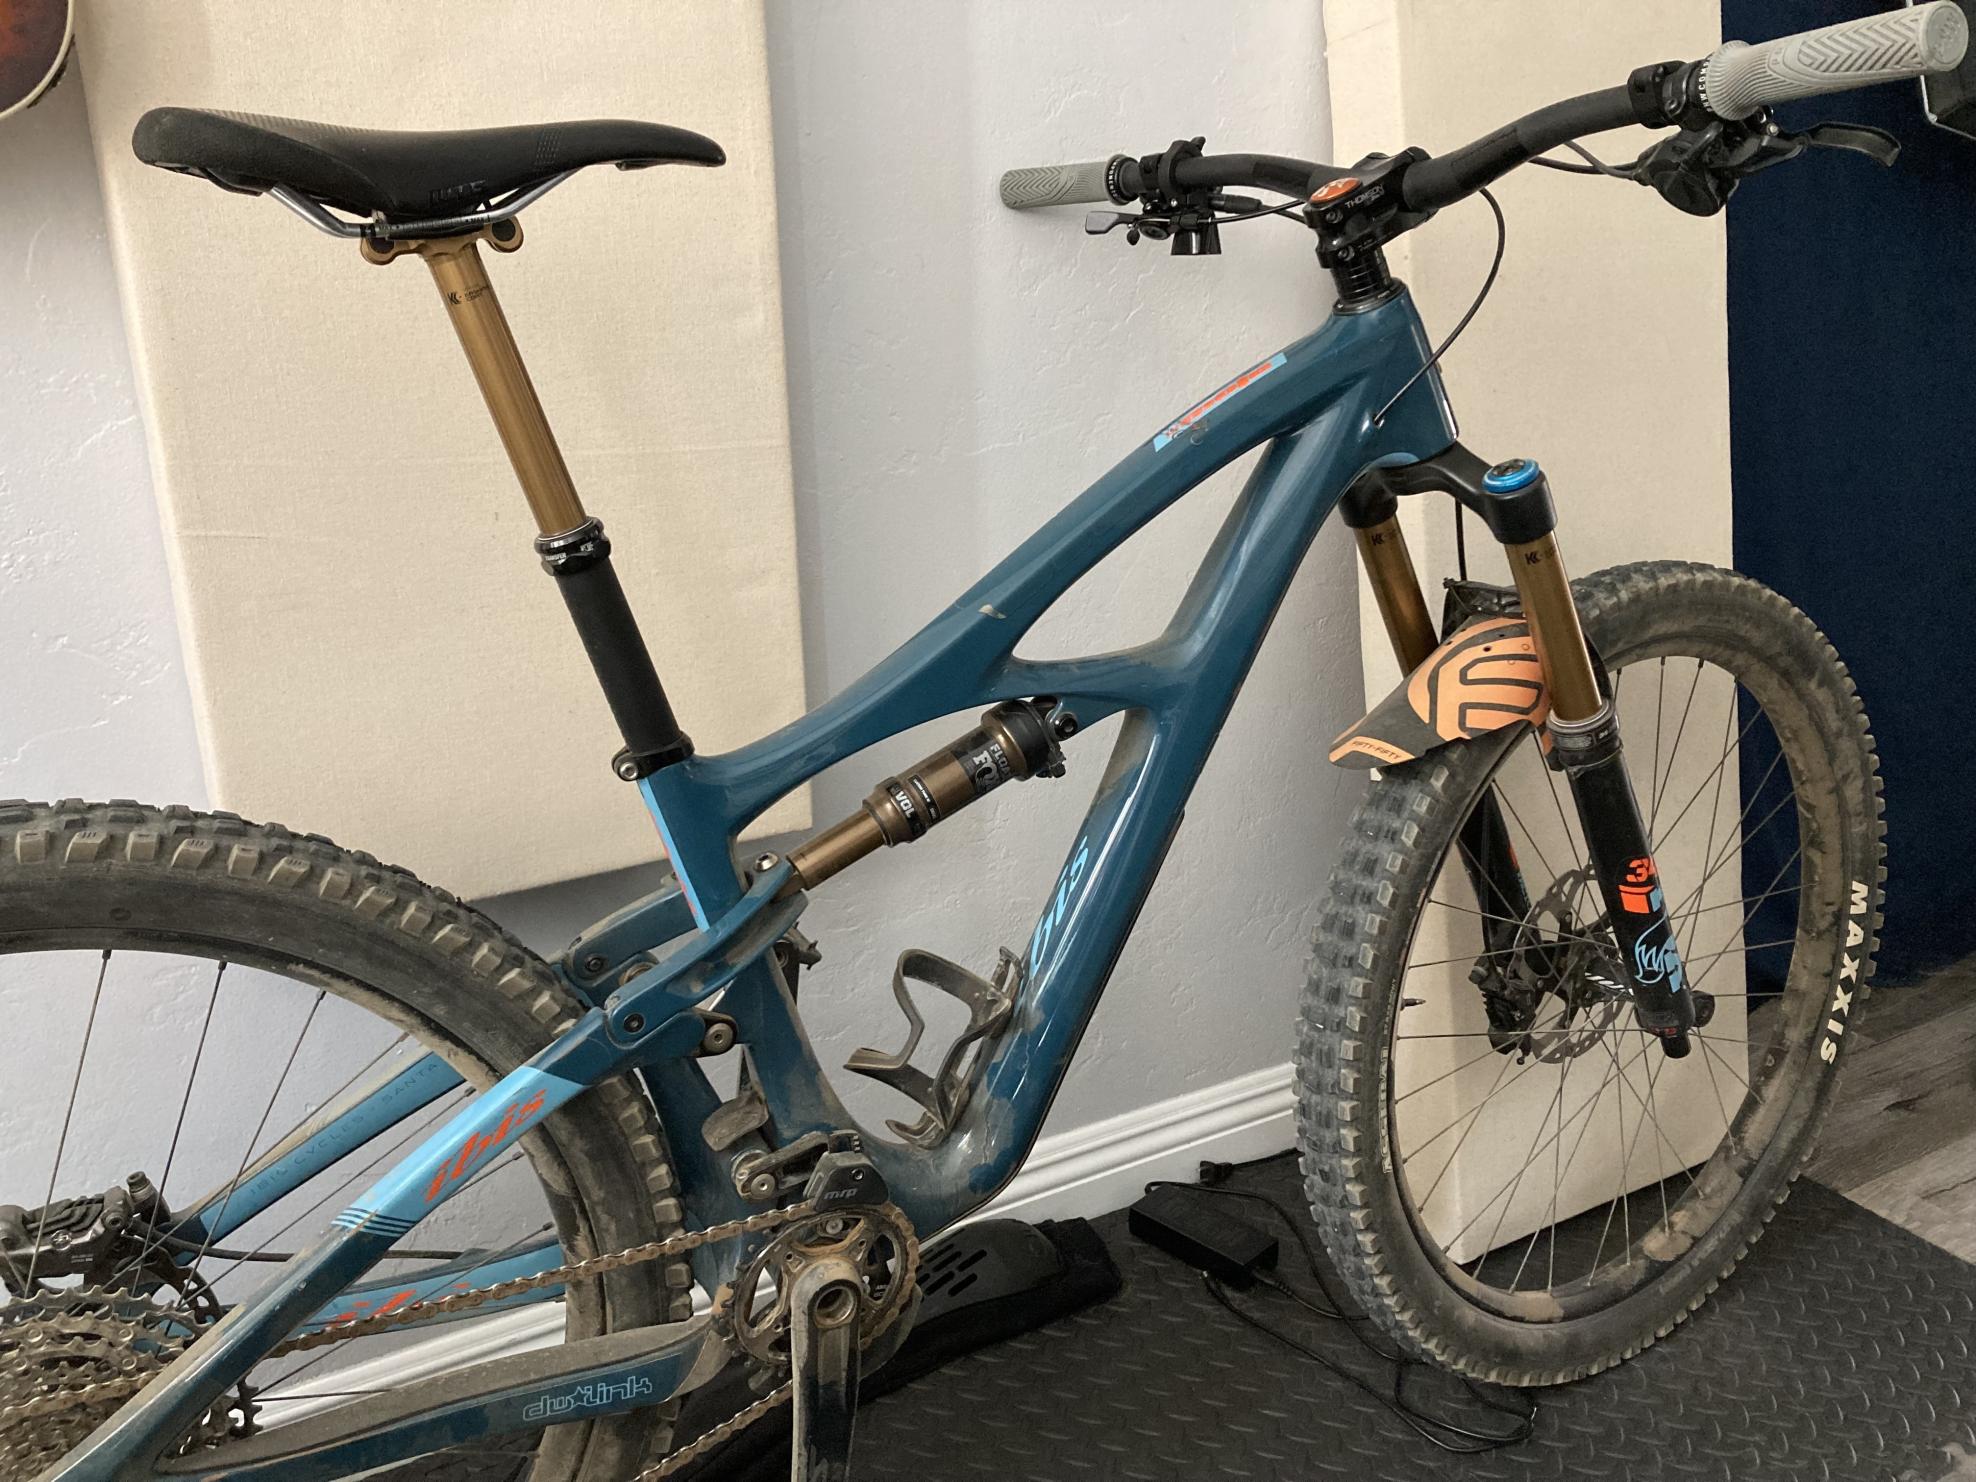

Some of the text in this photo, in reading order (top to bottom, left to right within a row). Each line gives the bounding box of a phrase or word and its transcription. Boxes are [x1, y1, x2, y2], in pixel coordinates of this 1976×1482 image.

[1344, 183, 1385, 209] THOMSON
[1820, 880, 1869, 1074] MAXXIS
[381, 1063, 438, 1106] SANTA
[423, 1088, 548, 1204] ibis
[823, 1187, 858, 1201] mrp
